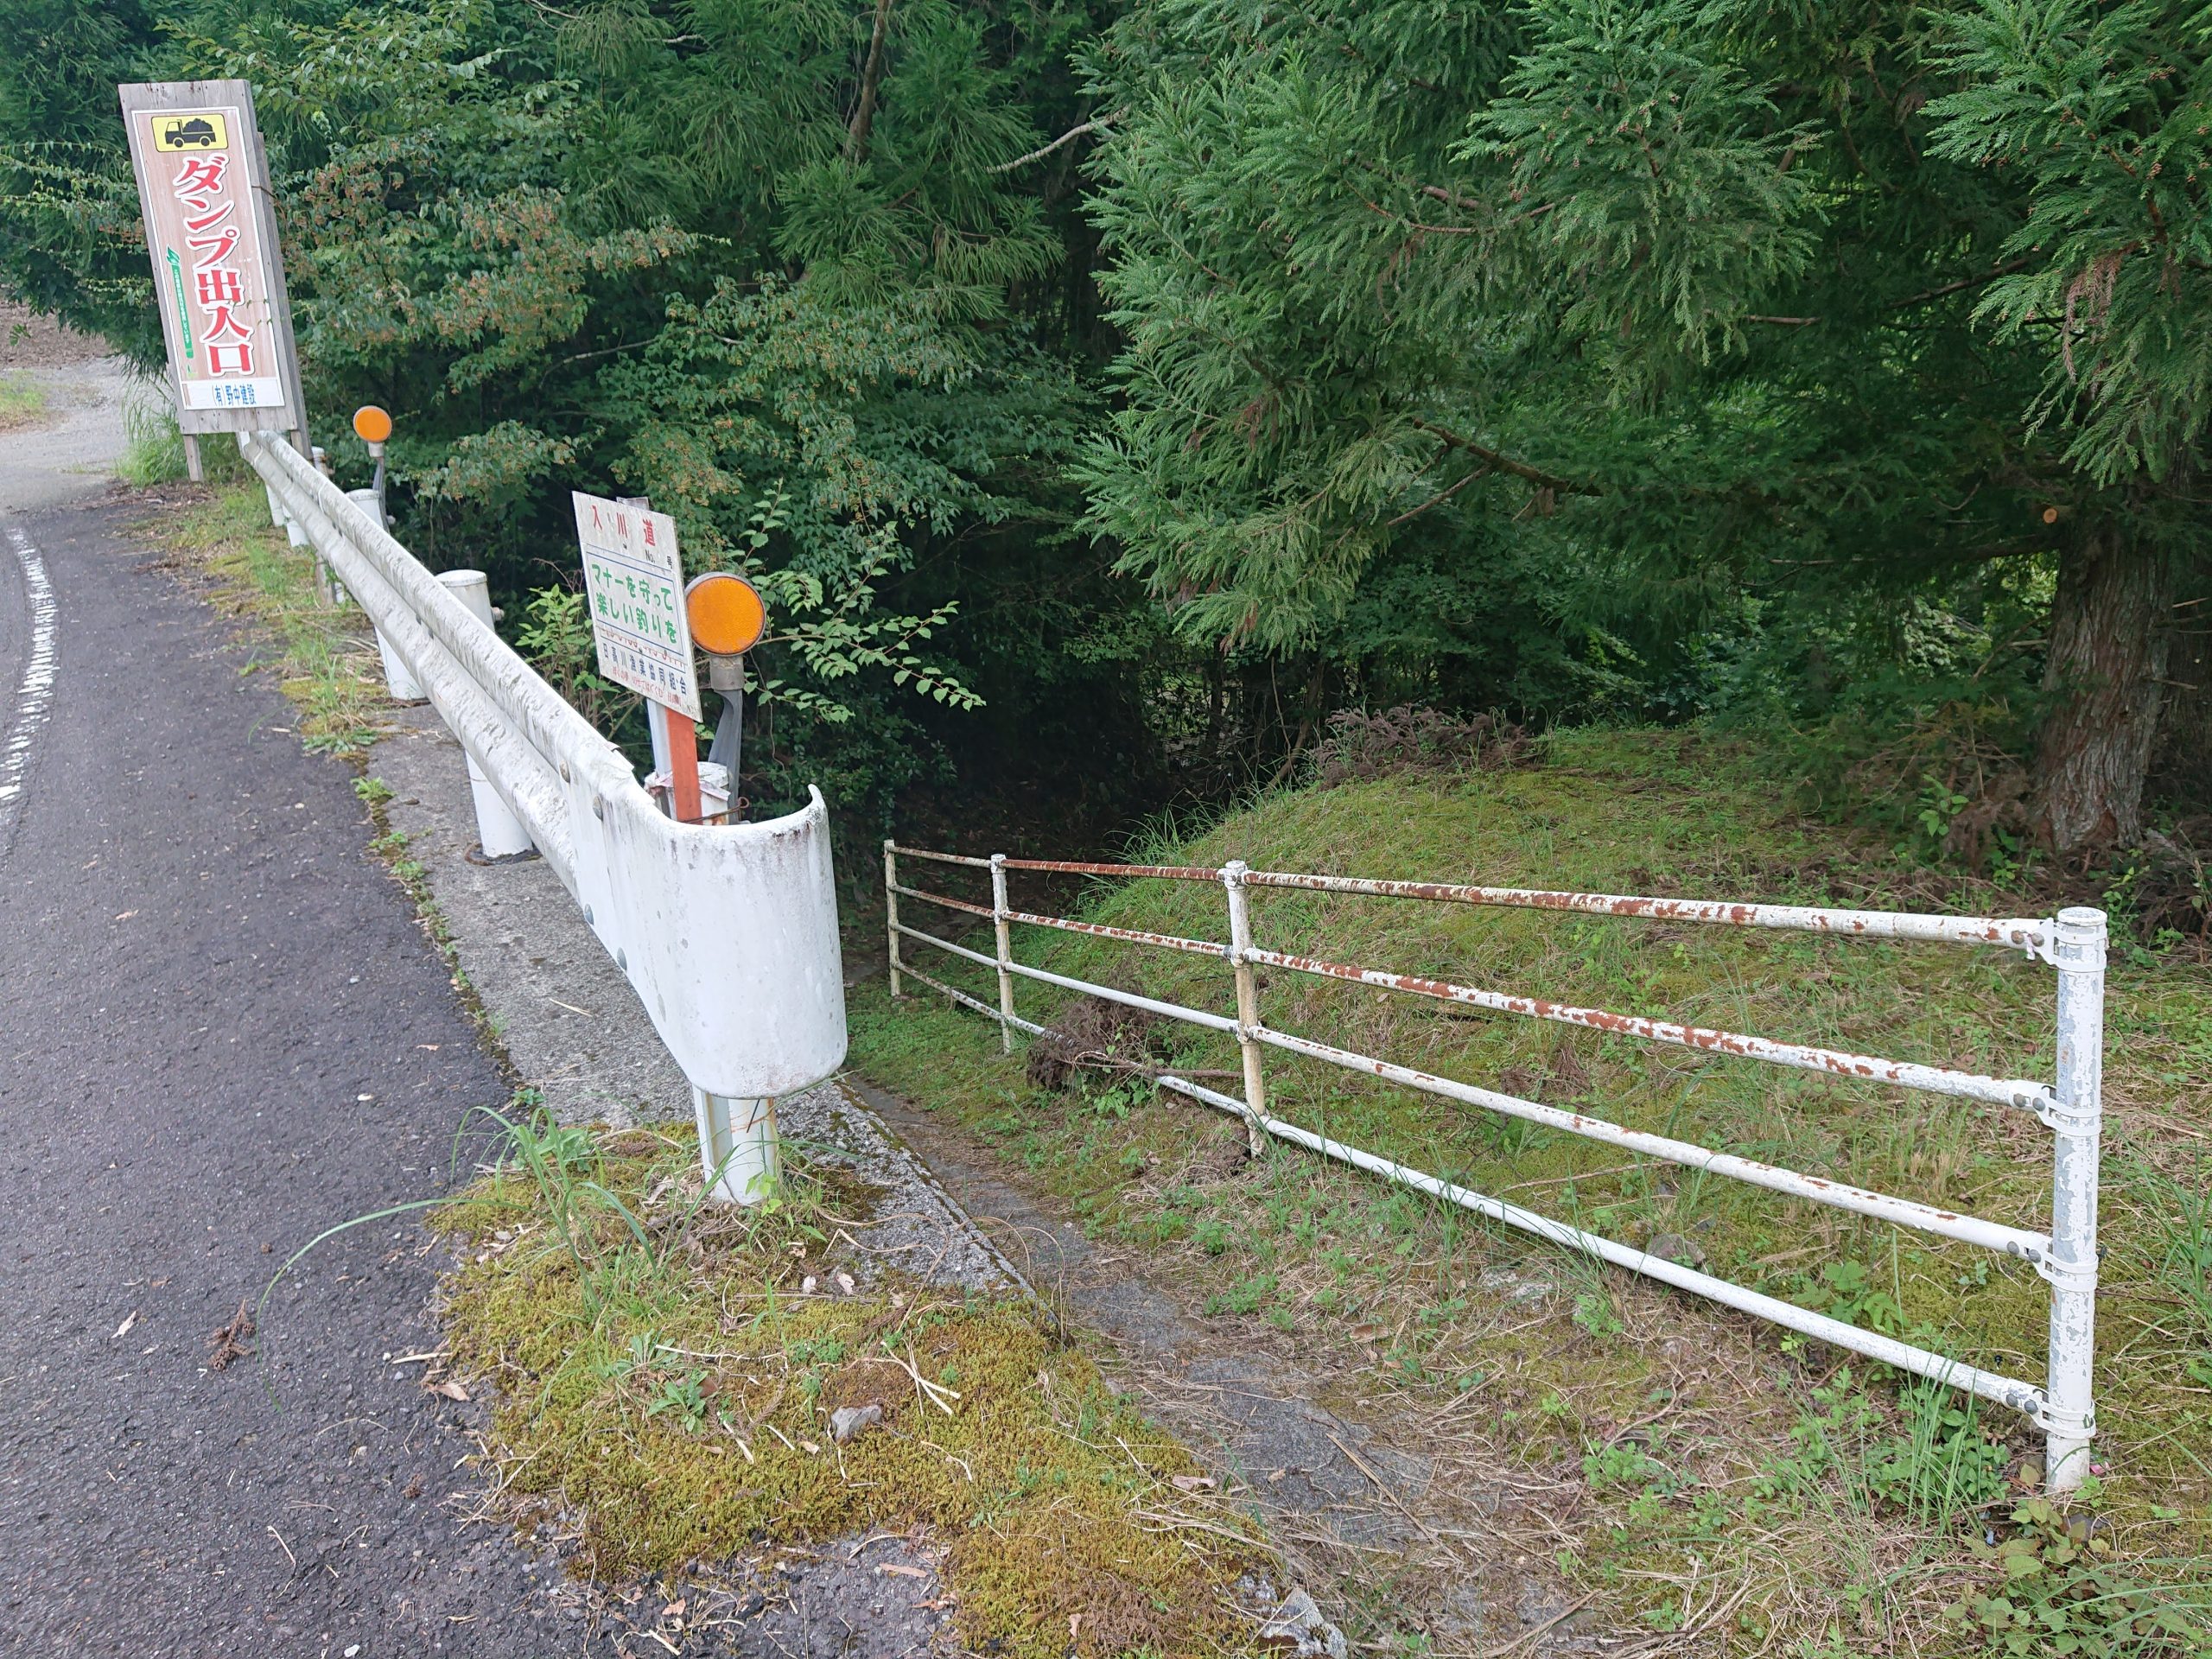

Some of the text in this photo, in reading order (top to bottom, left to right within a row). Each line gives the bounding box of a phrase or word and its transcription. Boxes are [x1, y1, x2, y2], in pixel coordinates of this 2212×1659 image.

[175, 156, 251, 375] ダンプ出入口
[212, 384, 257, 406] (有)野中建設
[592, 505, 655, 546] 入川道
[645, 549, 655, 563] No.
[592, 563, 673, 612] マナーを守って
[595, 592, 677, 644] 楽しい釣りを
